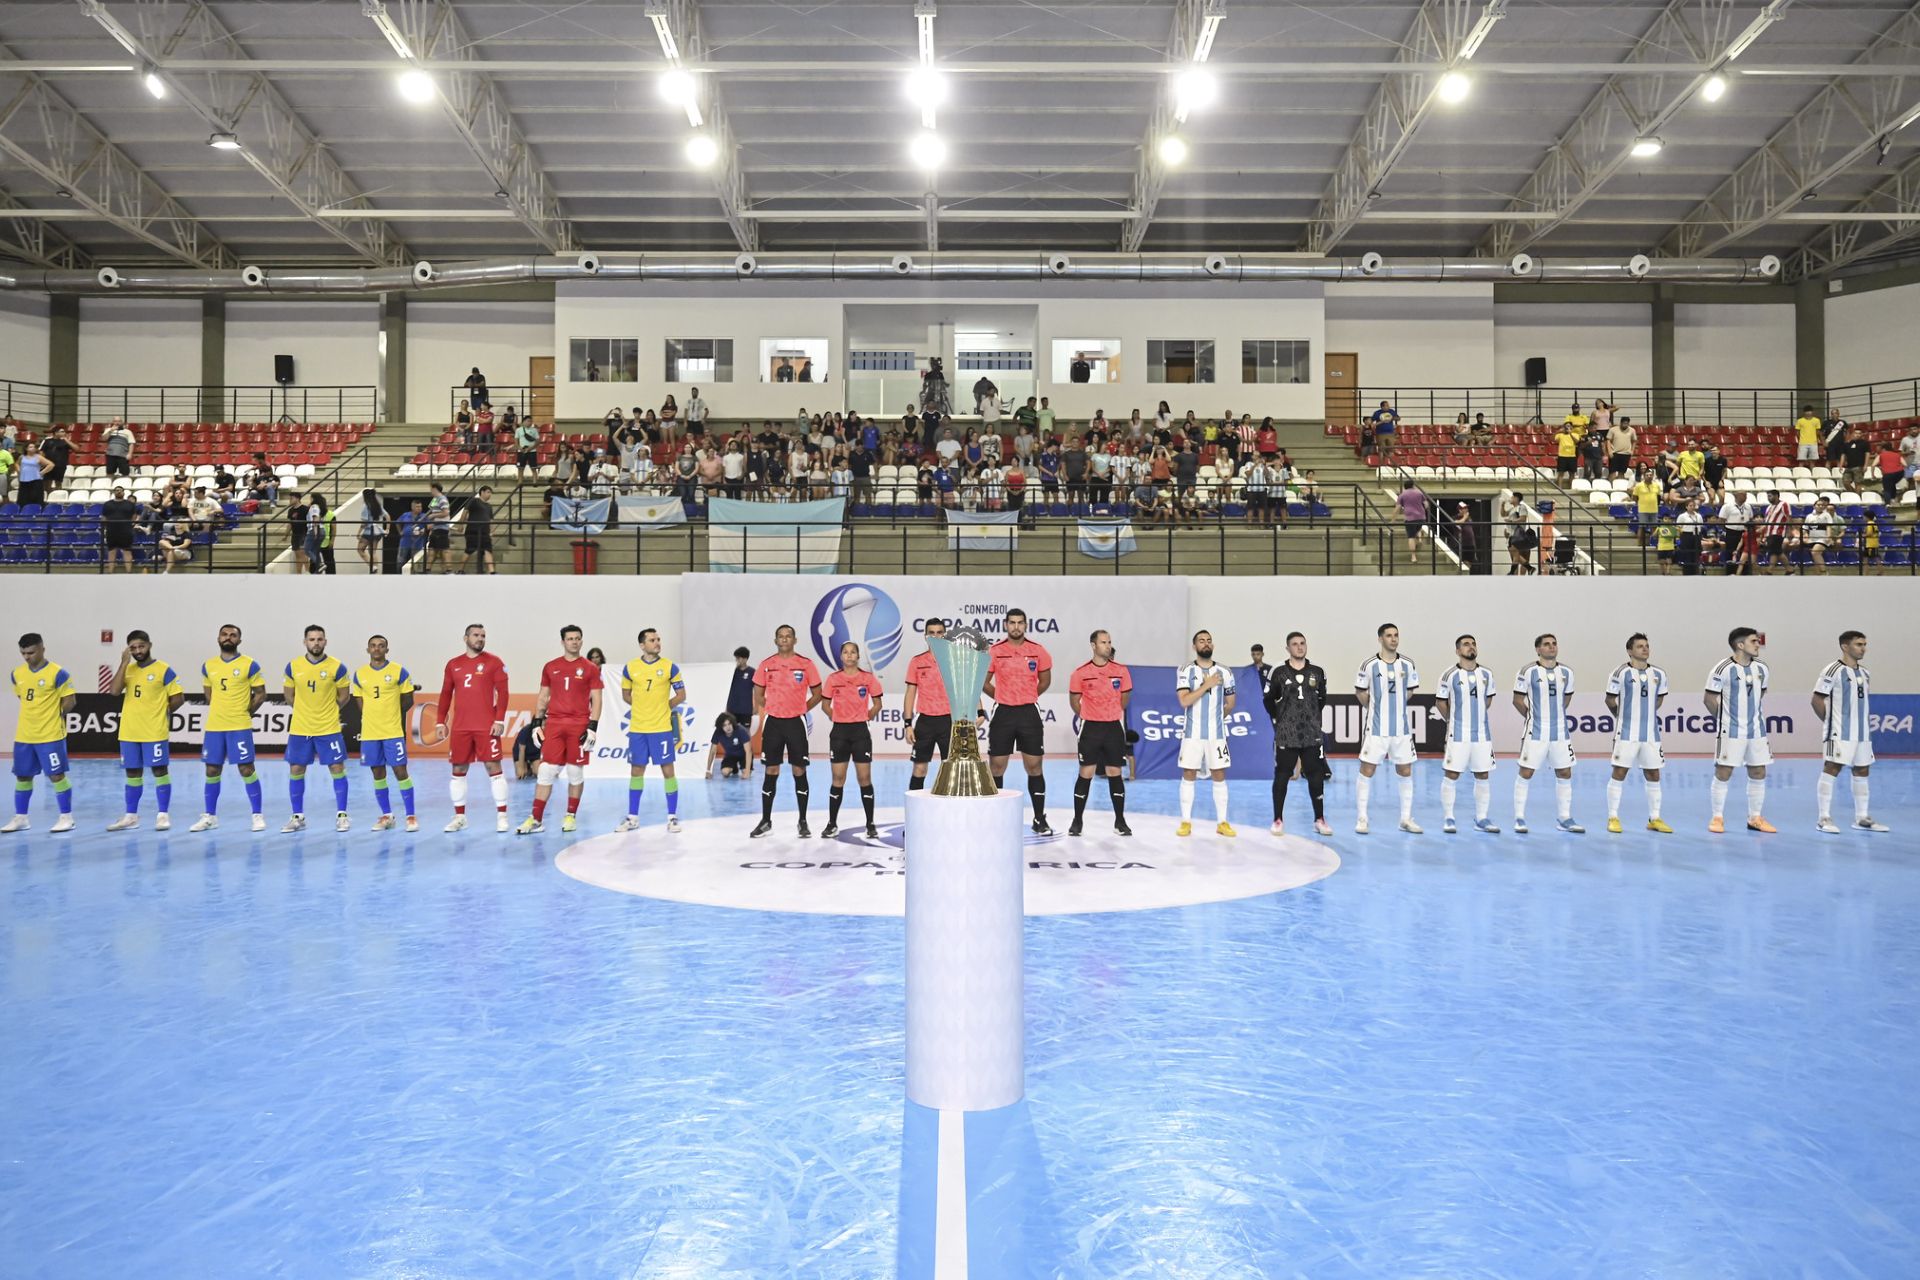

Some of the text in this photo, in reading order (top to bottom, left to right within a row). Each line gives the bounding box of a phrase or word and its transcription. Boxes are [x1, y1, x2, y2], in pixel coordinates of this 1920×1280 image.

[913, 618, 962, 633] CPA
[220, 678, 227, 691] 5
[307, 679, 316, 693] 4
[464, 673, 473, 688] 2
[564, 676, 570, 691] 1
[646, 679, 653, 692] 7
[1388, 680, 1396, 694] 2
[26, 688, 34, 701] 8
[134, 685, 141, 698] 6
[374, 686, 380, 699] 3
[1298, 685, 1305, 700] 1
[1470, 685, 1478, 699] 4
[1549, 683, 1557, 697] 5
[1640, 684, 1648, 698] 6
[1746, 684, 1753, 697] 7
[1858, 686, 1864, 699] 8
[169, 713, 202, 732] DE
[153, 743, 162, 758] 6
[237, 741, 248, 755] 5
[330, 740, 341, 754] 4
[396, 742, 404, 756] 3
[490, 738, 499, 753] 2
[1216, 745, 1230, 760] 14
[1319, 744, 1325, 760] 1
[49, 752, 60, 767] 8
[739, 861, 1157, 870] COPA RICA
